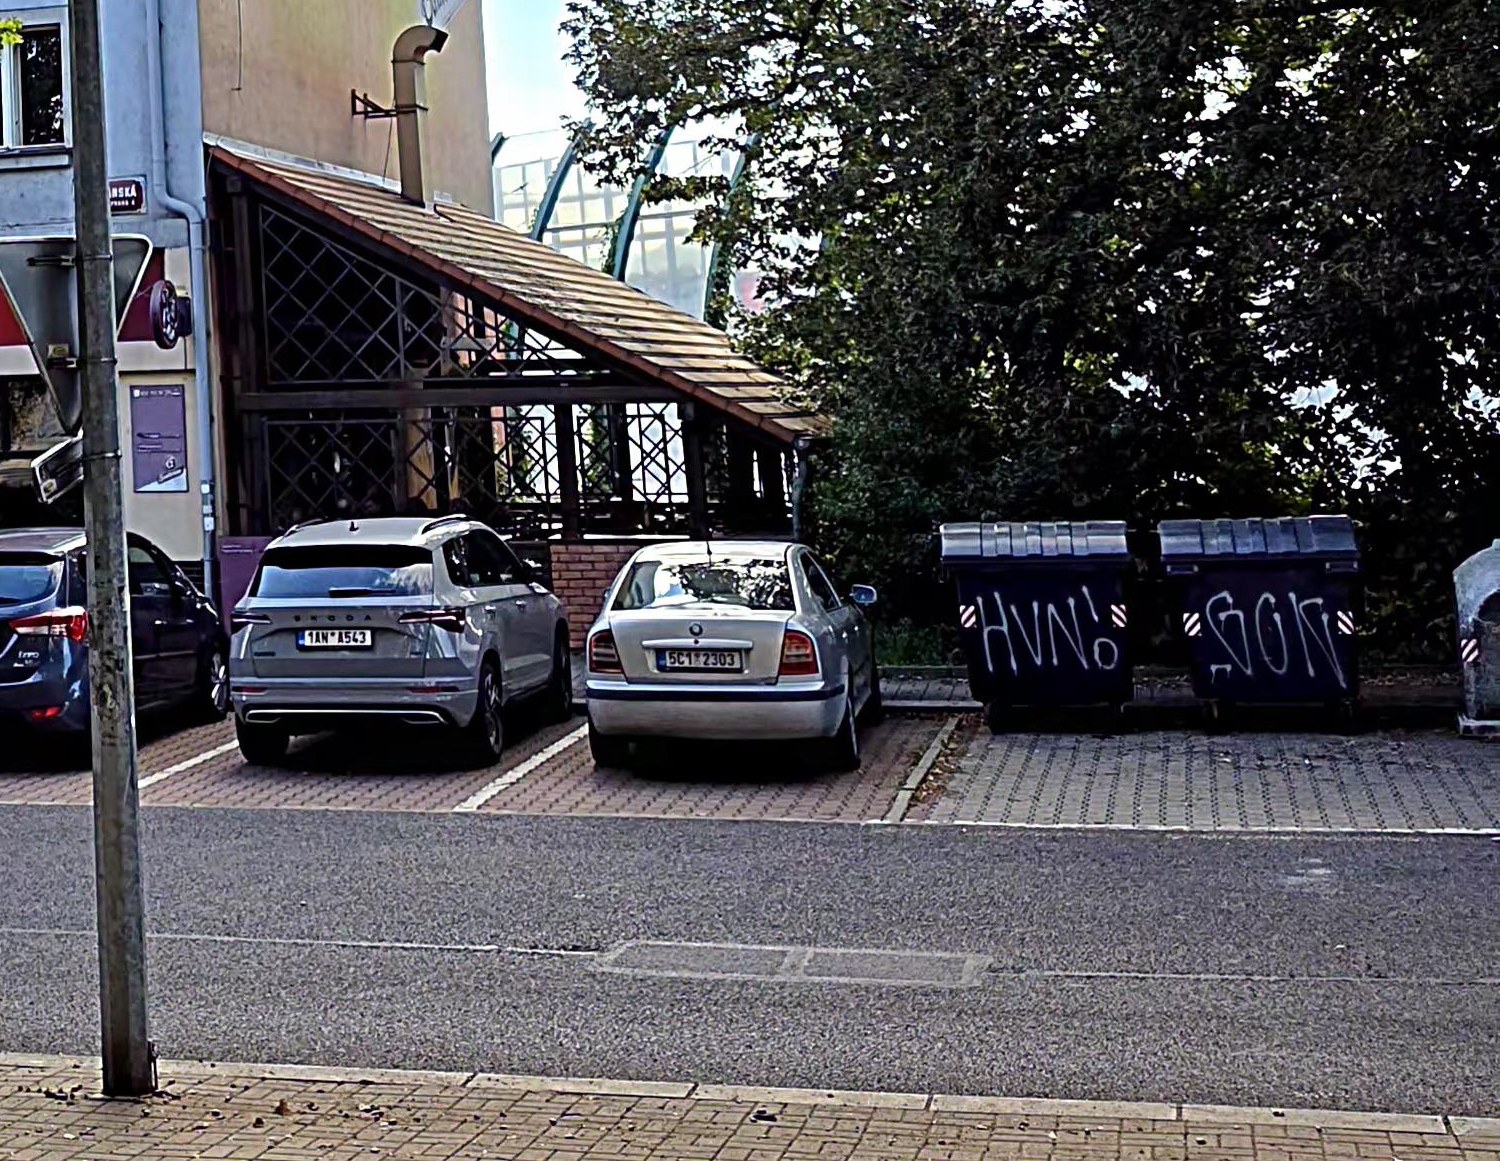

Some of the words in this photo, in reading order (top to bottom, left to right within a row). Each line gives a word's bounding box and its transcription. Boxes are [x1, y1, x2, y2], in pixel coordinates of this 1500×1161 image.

[307, 631, 328, 644] 1AN
[337, 631, 366, 644] A543
[668, 651, 694, 665] 5C1
[702, 652, 735, 666] 2303
